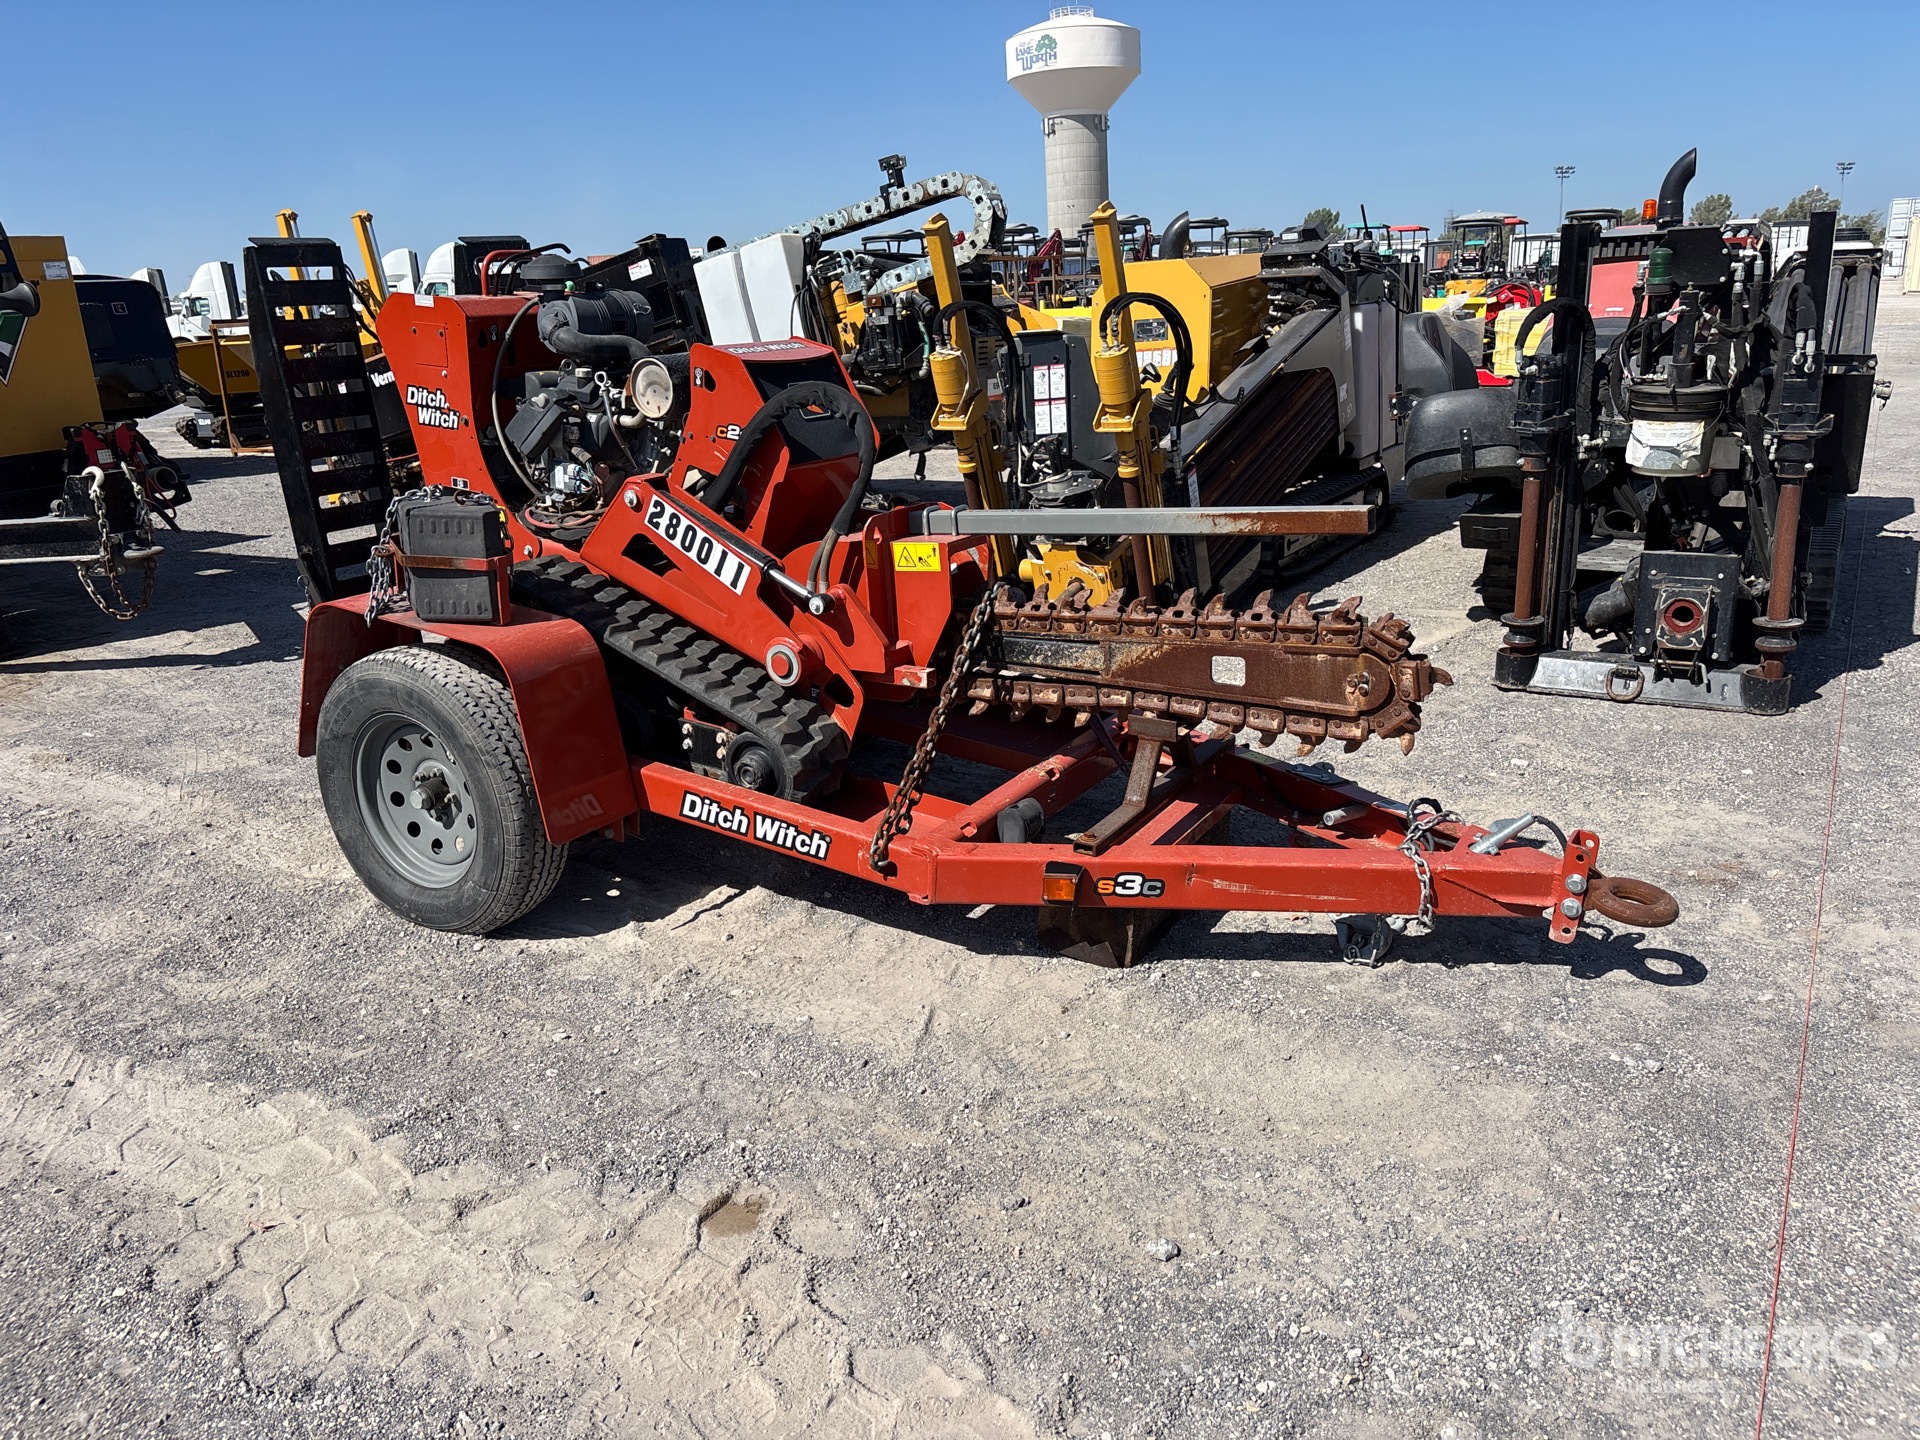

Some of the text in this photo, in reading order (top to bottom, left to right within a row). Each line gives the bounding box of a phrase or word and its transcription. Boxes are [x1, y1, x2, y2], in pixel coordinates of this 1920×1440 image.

[1015, 46, 1034, 61] LAKE
[1022, 51, 1057, 71] WORTH
[727, 342, 805, 354] Ditch Witch
[406, 386, 446, 408] Ditch
[417, 406, 459, 429] Witch
[646, 499, 746, 591] 280011
[682, 793, 830, 858] Ditch Witch
